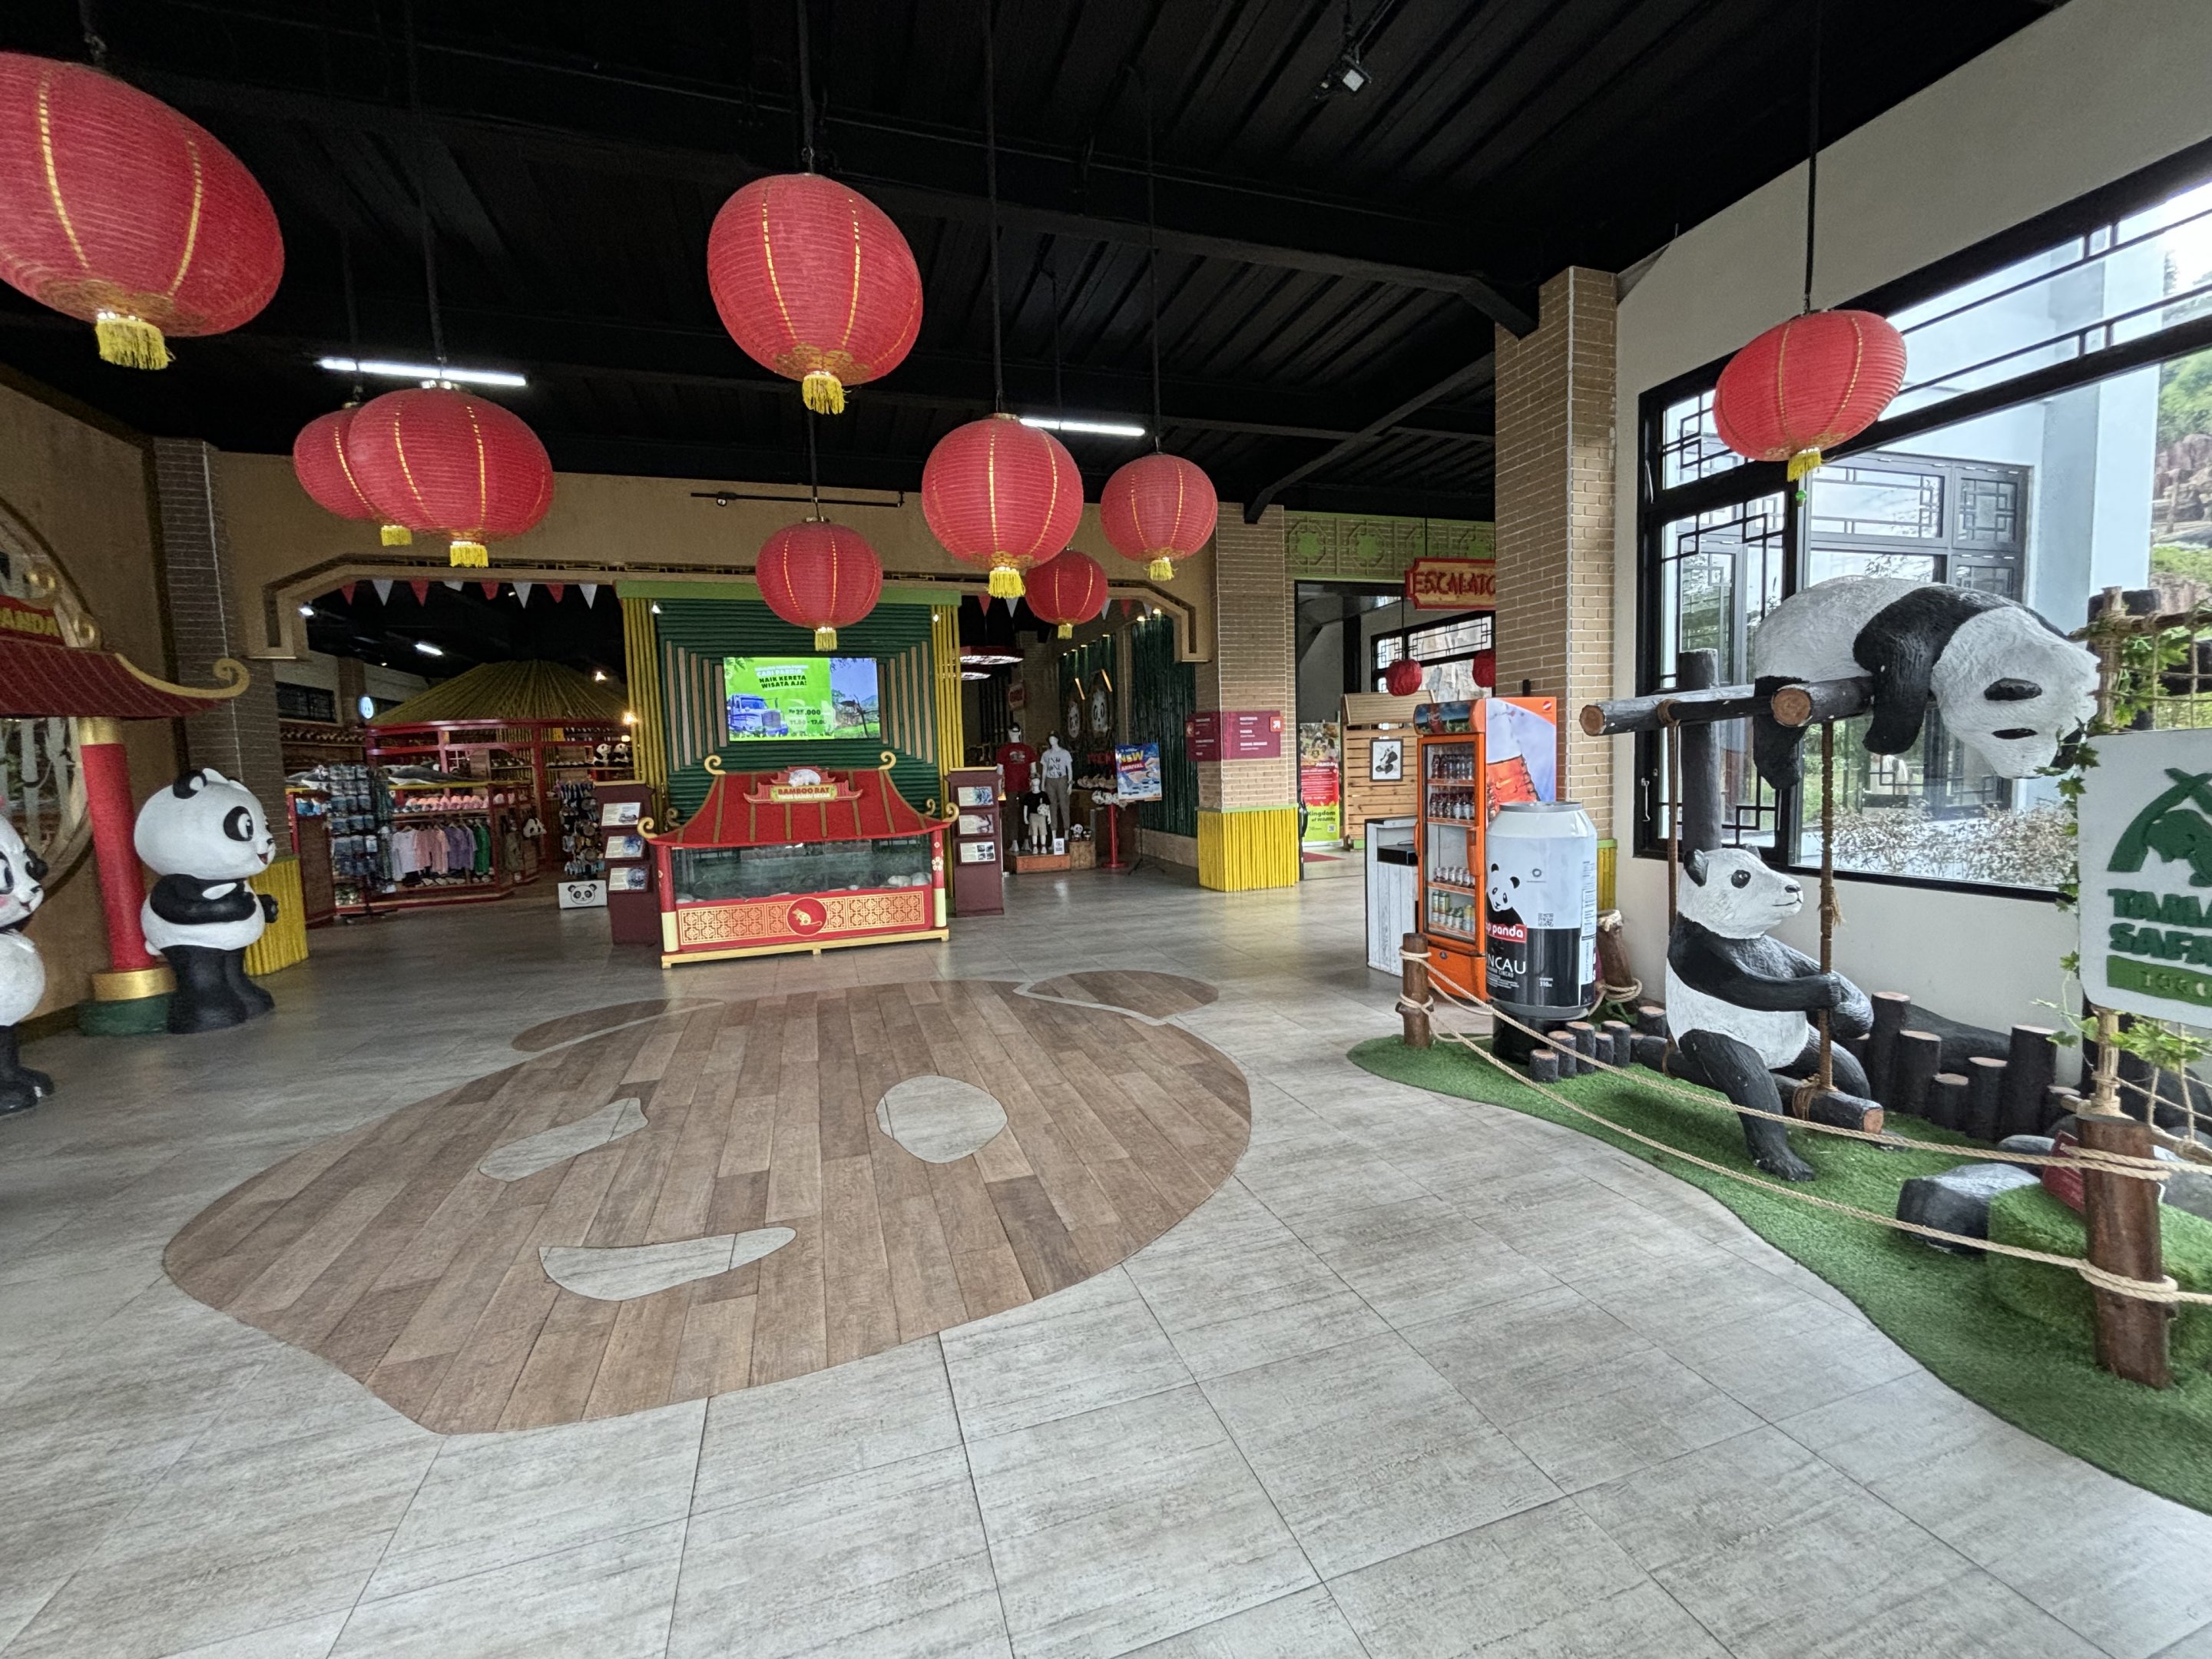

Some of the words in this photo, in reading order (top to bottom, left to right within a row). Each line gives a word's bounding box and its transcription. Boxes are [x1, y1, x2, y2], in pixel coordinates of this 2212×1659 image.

[1118, 750, 1144, 763] NEW
[1121, 763, 1144, 771] ARRIVAL
[1492, 925, 1524, 939] panda
[1487, 953, 1526, 975] NCAU
